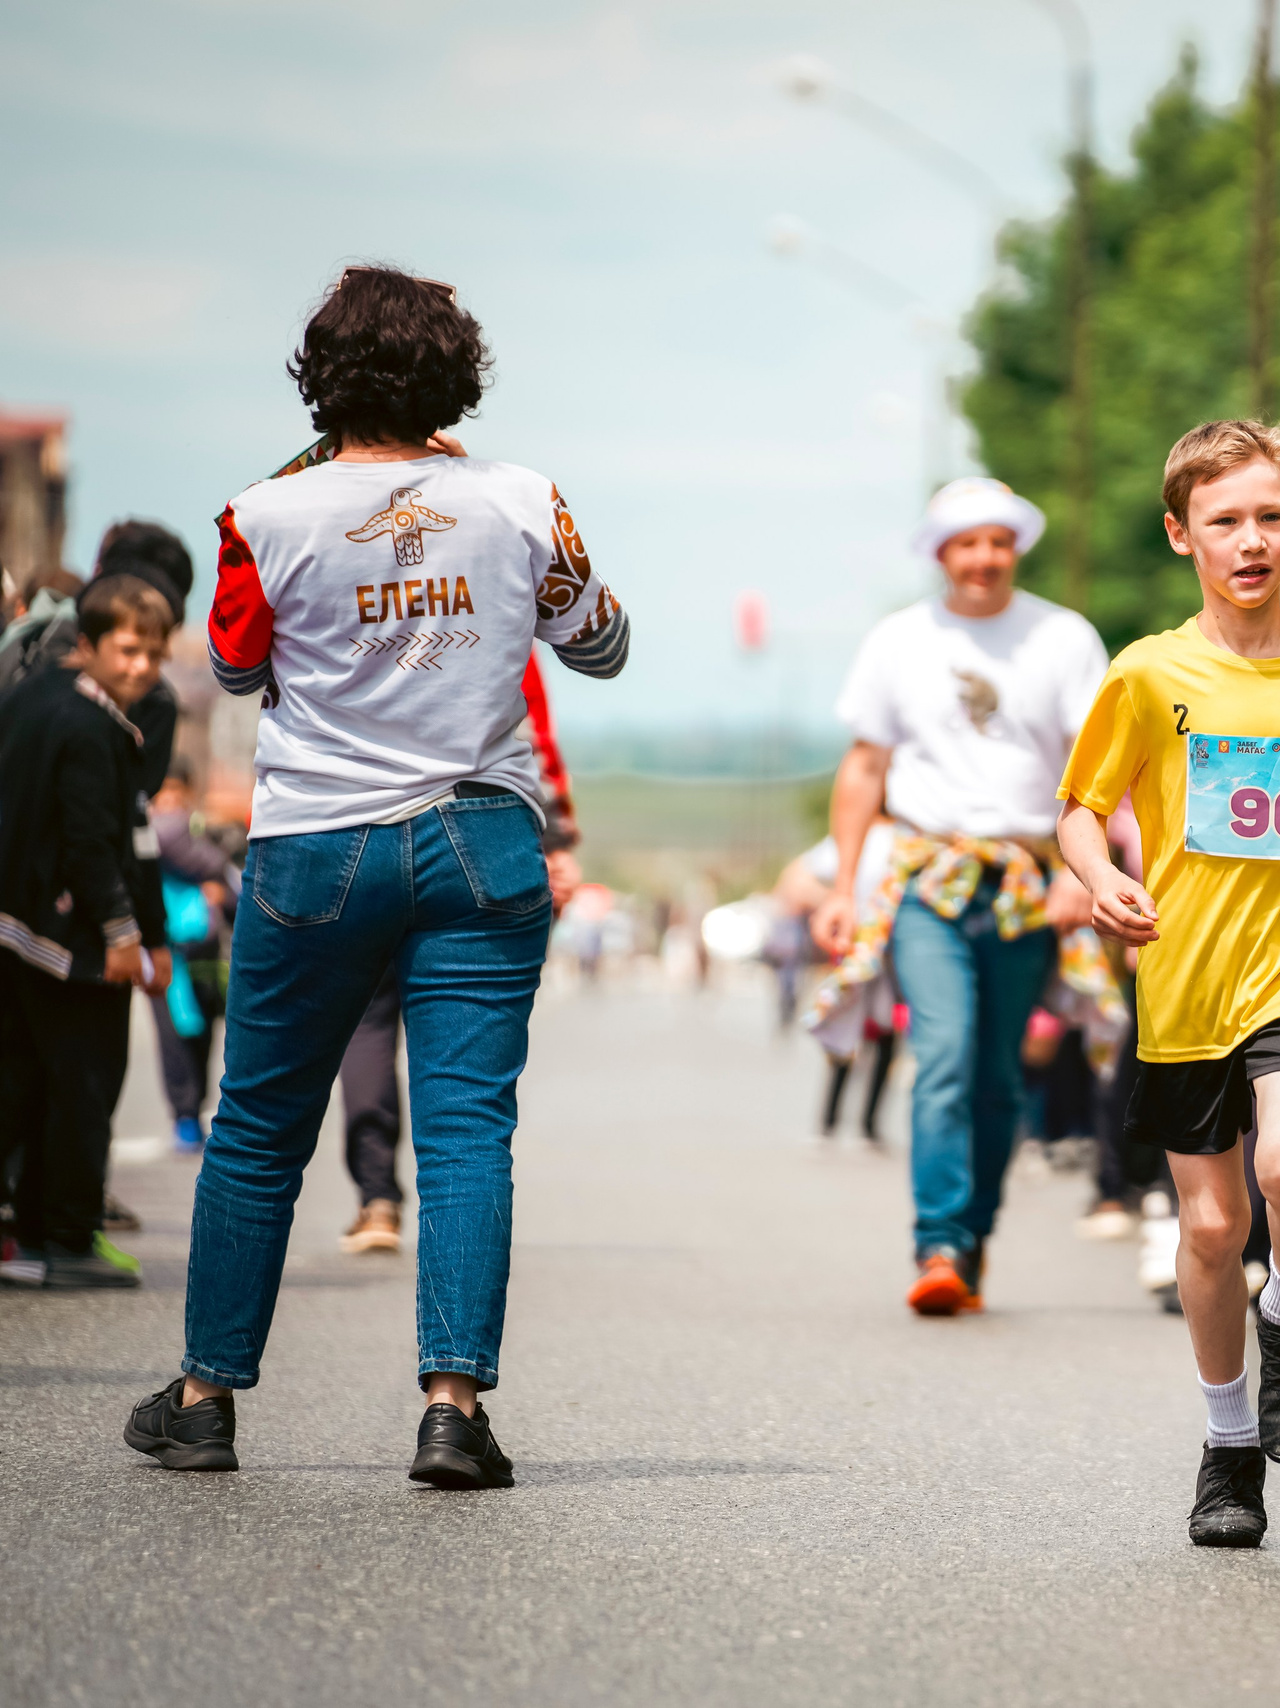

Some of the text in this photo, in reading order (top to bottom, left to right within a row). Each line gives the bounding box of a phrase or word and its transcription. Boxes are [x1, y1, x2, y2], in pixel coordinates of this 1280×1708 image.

[356, 575, 475, 625] ЕЛЕНА
[1173, 704, 1190, 735] 2
[1236, 746, 1266, 754] МАГАС
